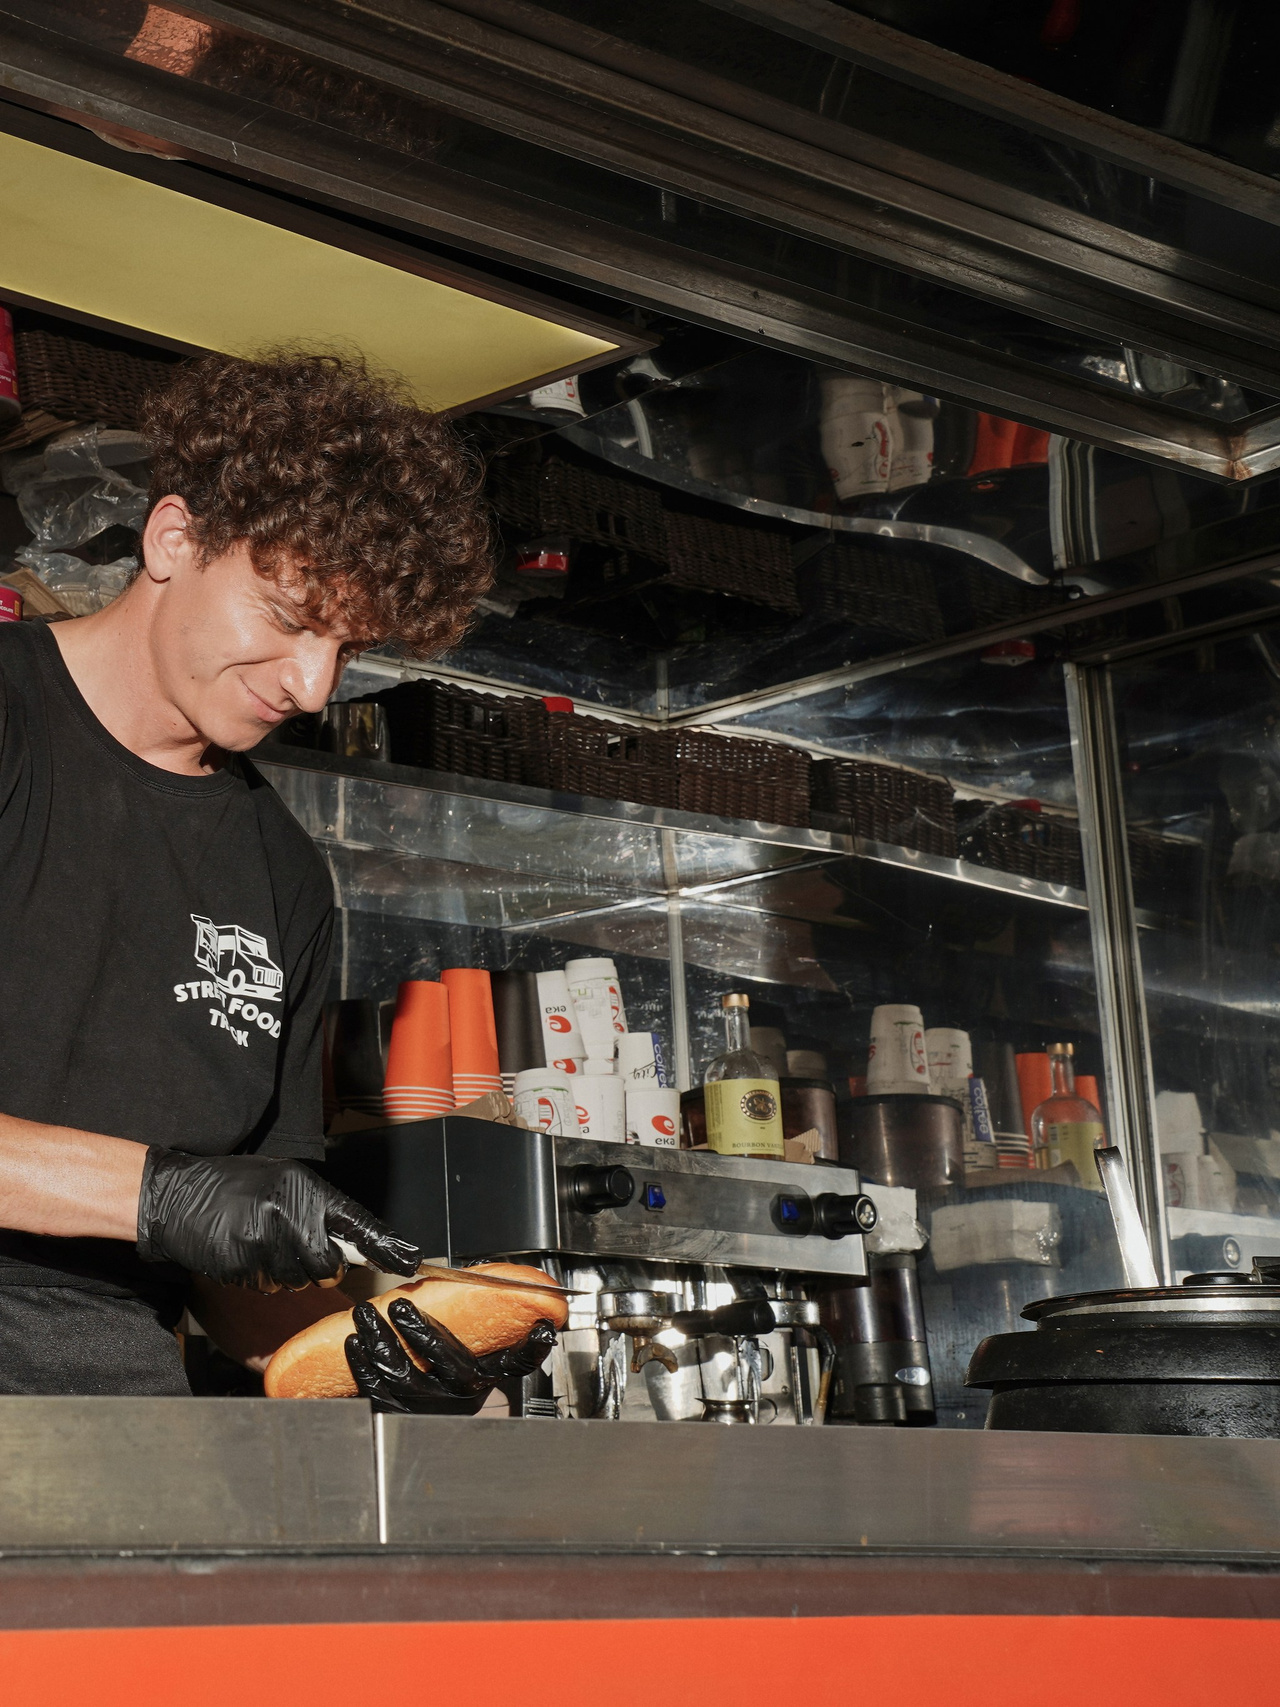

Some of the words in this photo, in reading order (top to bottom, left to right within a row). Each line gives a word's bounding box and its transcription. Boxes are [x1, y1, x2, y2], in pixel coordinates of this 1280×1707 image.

[173, 981, 227, 1008] STRET
[228, 997, 282, 1039] FOOD
[209, 1008, 249, 1048] TRCK
